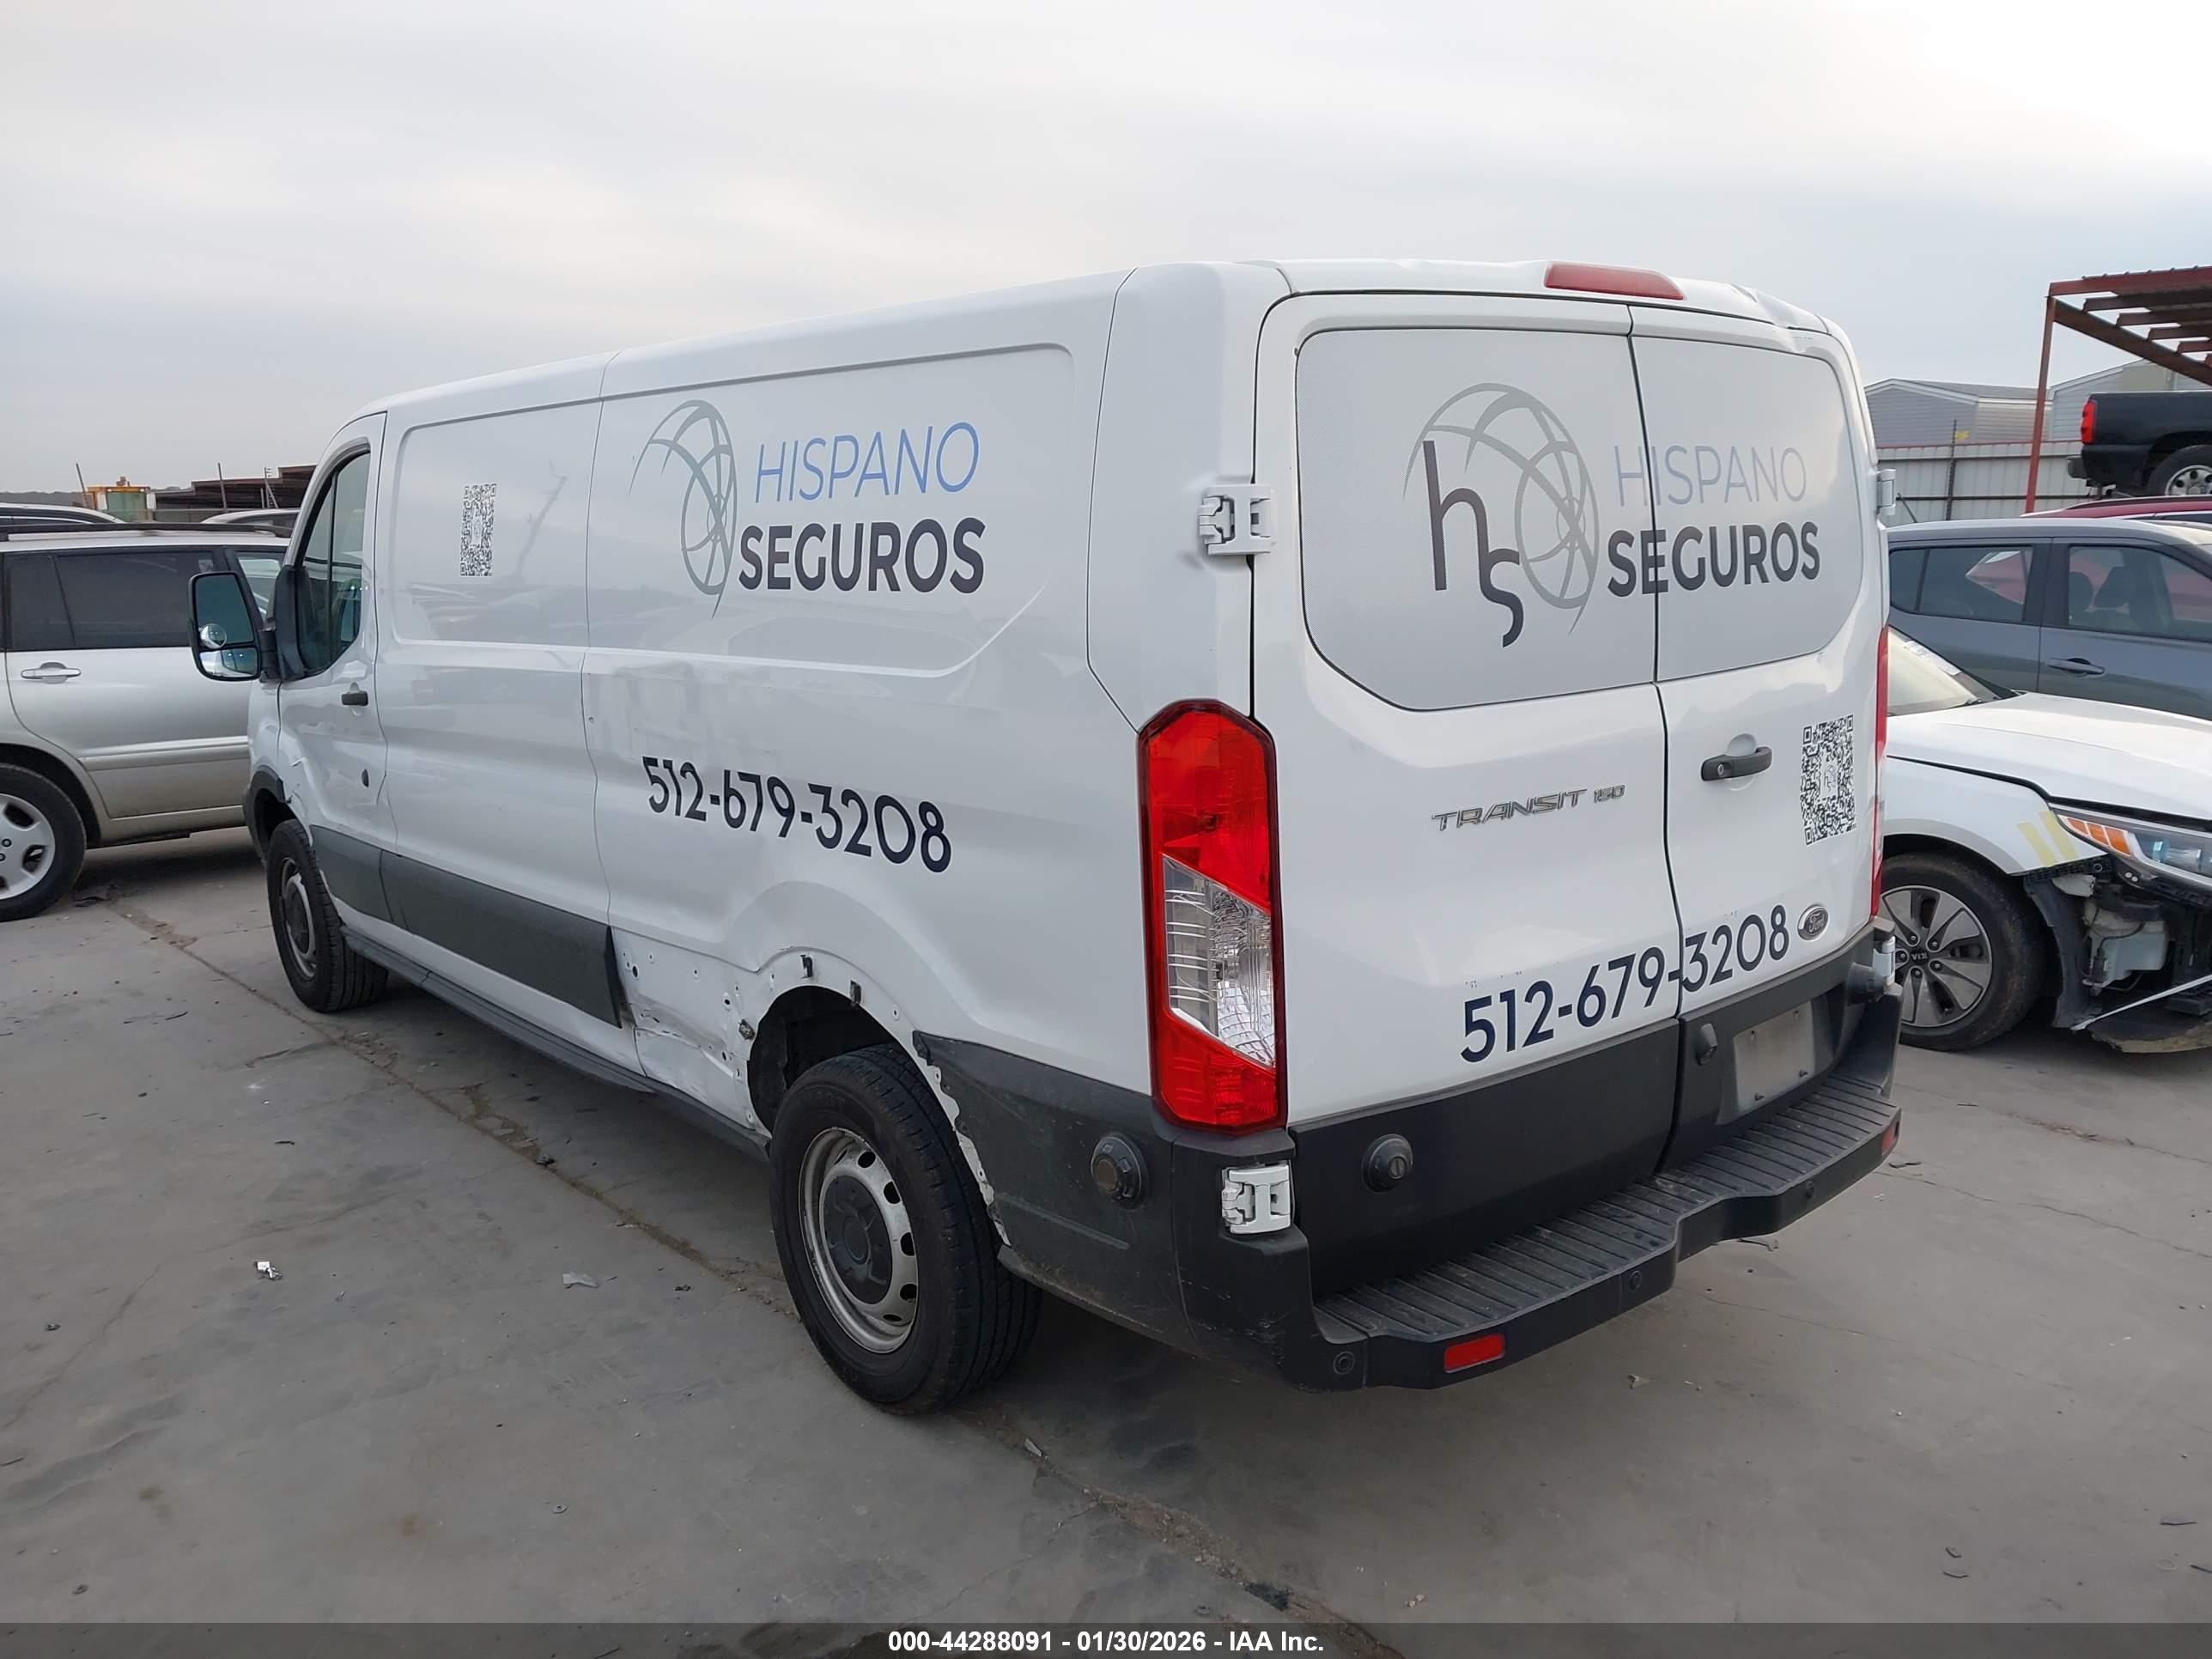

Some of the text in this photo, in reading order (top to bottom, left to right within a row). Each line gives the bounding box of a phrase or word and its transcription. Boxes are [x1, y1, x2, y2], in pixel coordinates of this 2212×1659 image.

[756, 422, 979, 503] HISPANO
[1614, 445, 1807, 507] HISPANO
[739, 518, 986, 593] SEGUROS
[1607, 521, 1820, 598] SEGUROS
[642, 757, 952, 873] 512-679-3208
[1431, 788, 1588, 831] TRANSIT
[1460, 904, 1790, 1063] 512-679-3208
